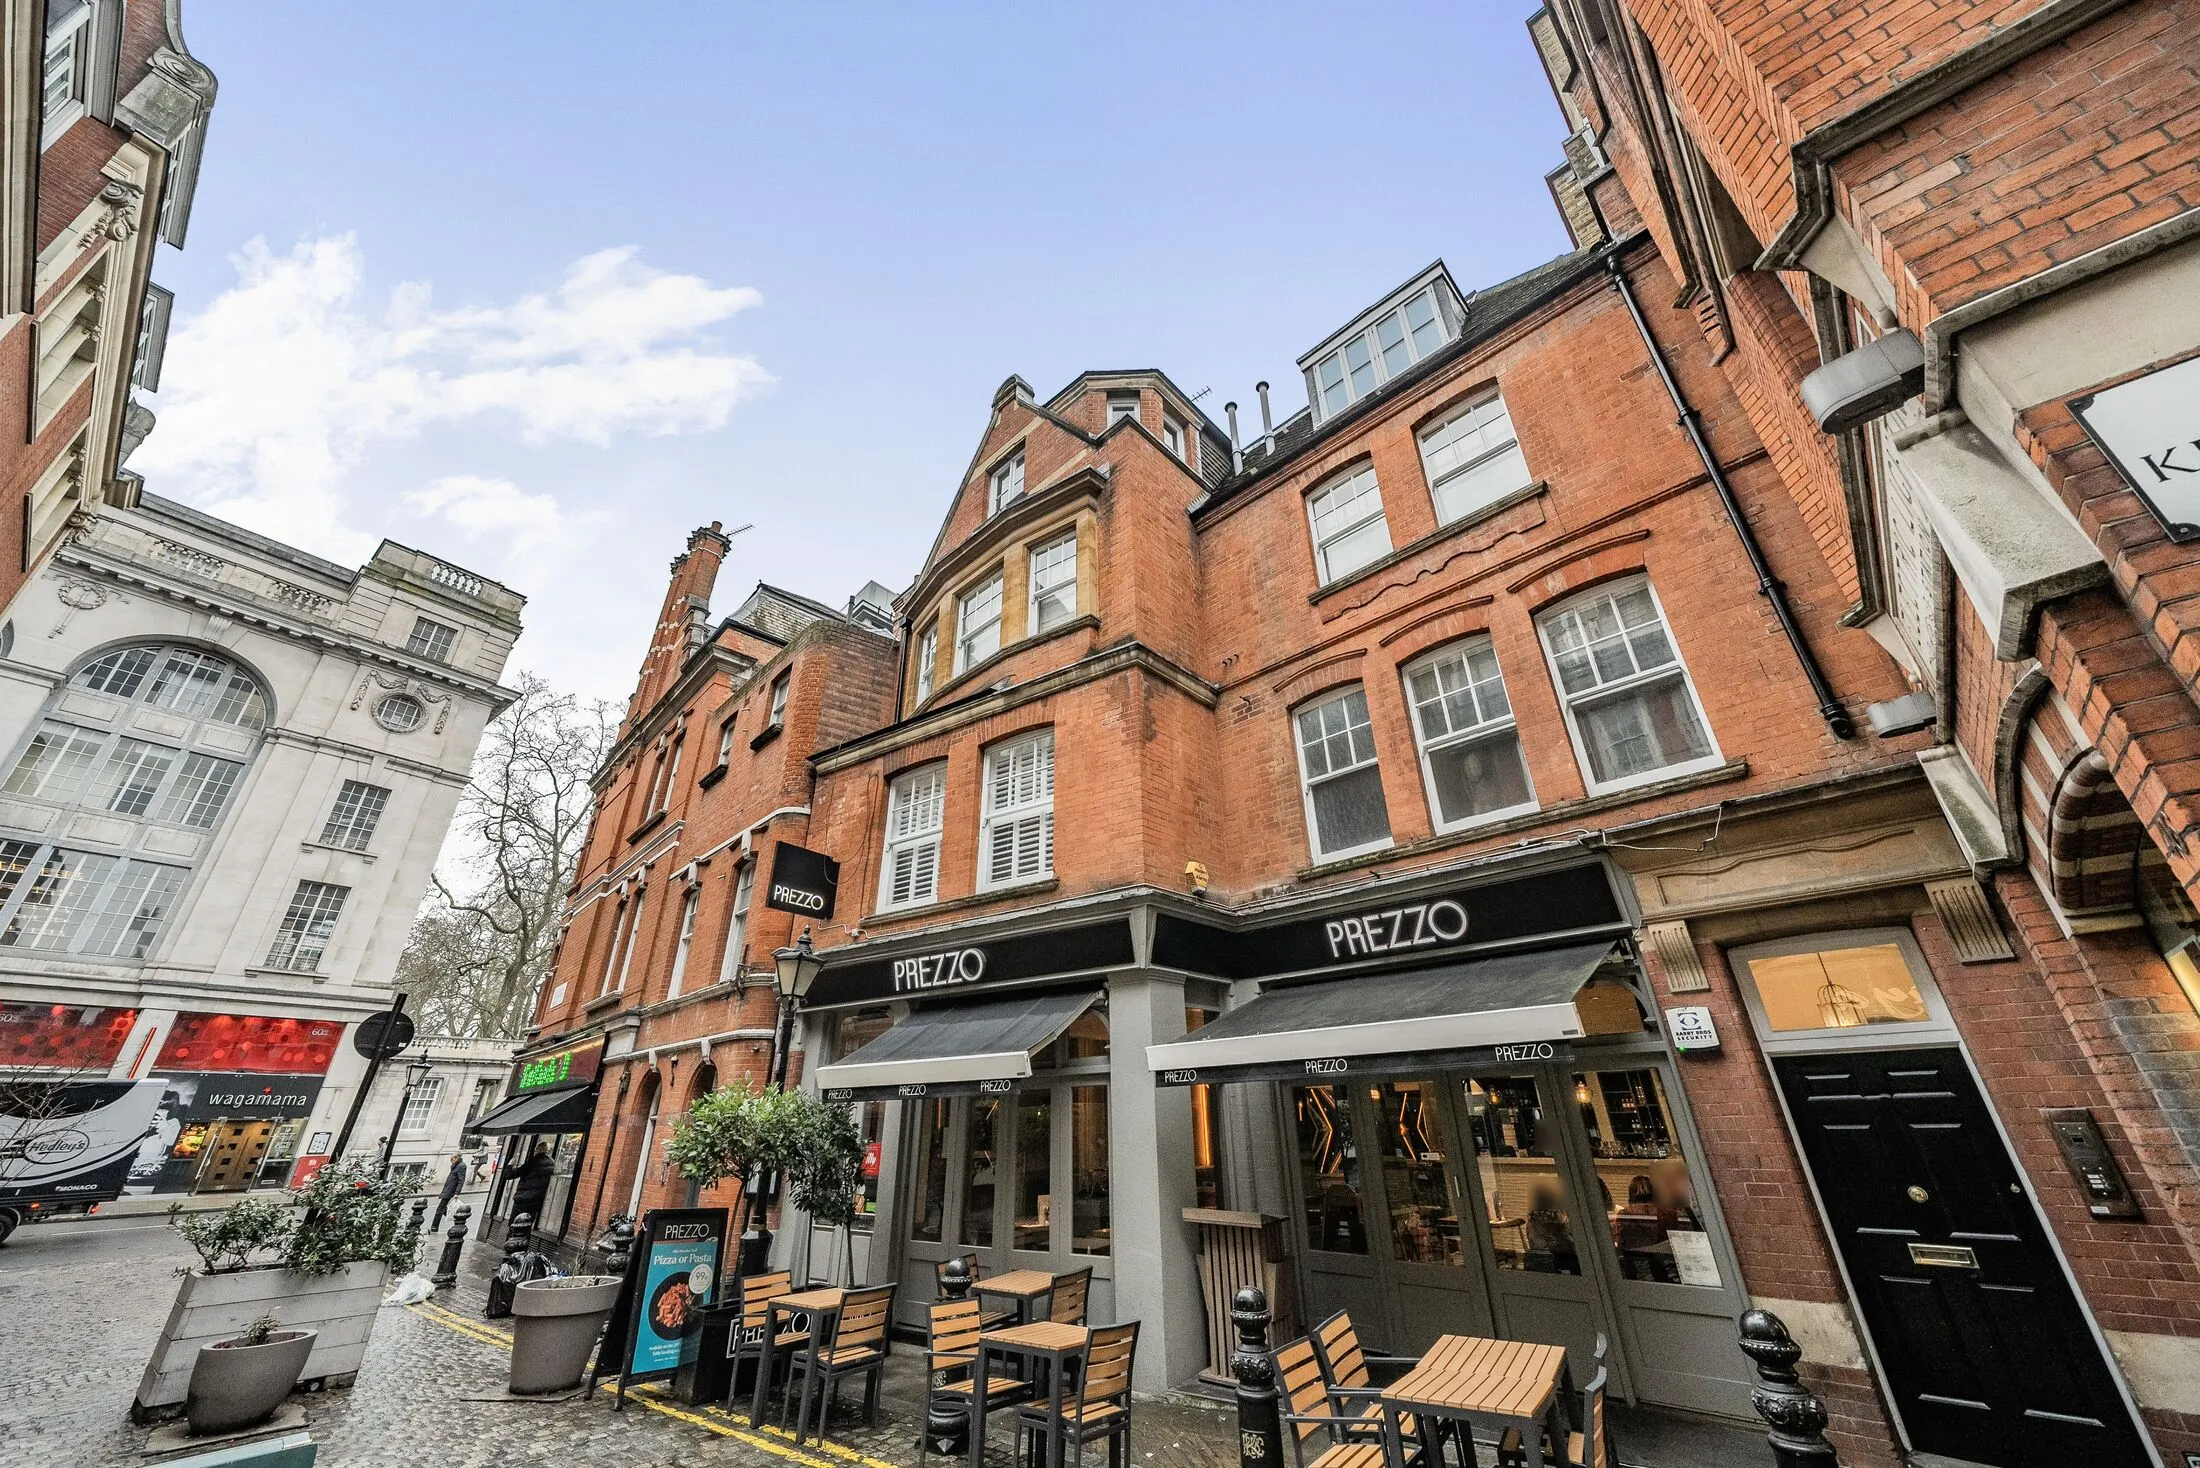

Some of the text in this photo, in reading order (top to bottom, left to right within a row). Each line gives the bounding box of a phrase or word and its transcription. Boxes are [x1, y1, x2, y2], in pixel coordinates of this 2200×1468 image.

[1917, 517, 1933, 599] STATION
[773, 884, 824, 911] PREZZO
[1325, 900, 1469, 957] PREZZO
[894, 948, 986, 991] PREZZO
[1495, 1042, 1554, 1062] PREZZO
[1305, 1058, 1348, 1074] PREZZO
[1164, 1069, 1197, 1083] PREZZO
[827, 1088, 853, 1099] PREZZO
[898, 1084, 927, 1096] PREZZO
[980, 1080, 1012, 1092] PREZZO
[209, 1093, 307, 1108] wagamama
[30, 1139, 86, 1152] Hedley's
[665, 1223, 710, 1239] PREZZO
[653, 1255, 677, 1265] Pizza
[689, 1253, 712, 1263] Pasta
